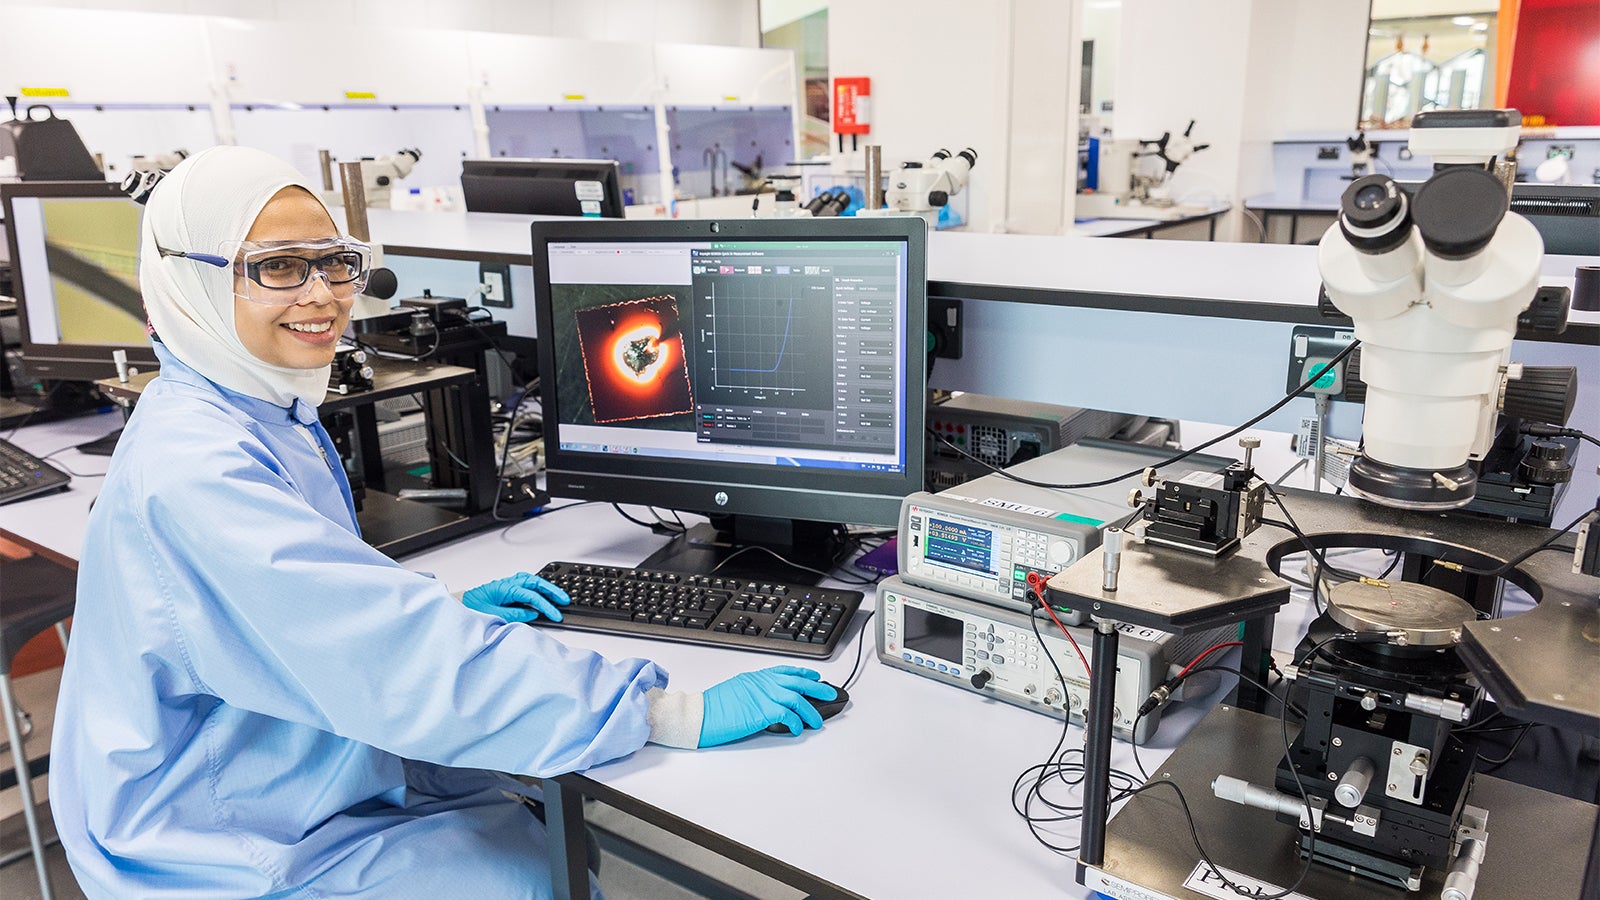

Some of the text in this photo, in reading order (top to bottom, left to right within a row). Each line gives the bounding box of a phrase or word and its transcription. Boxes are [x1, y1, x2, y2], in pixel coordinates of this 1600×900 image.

[1116, 620, 1155, 638] R 6
[1196, 867, 1283, 900] Prob
